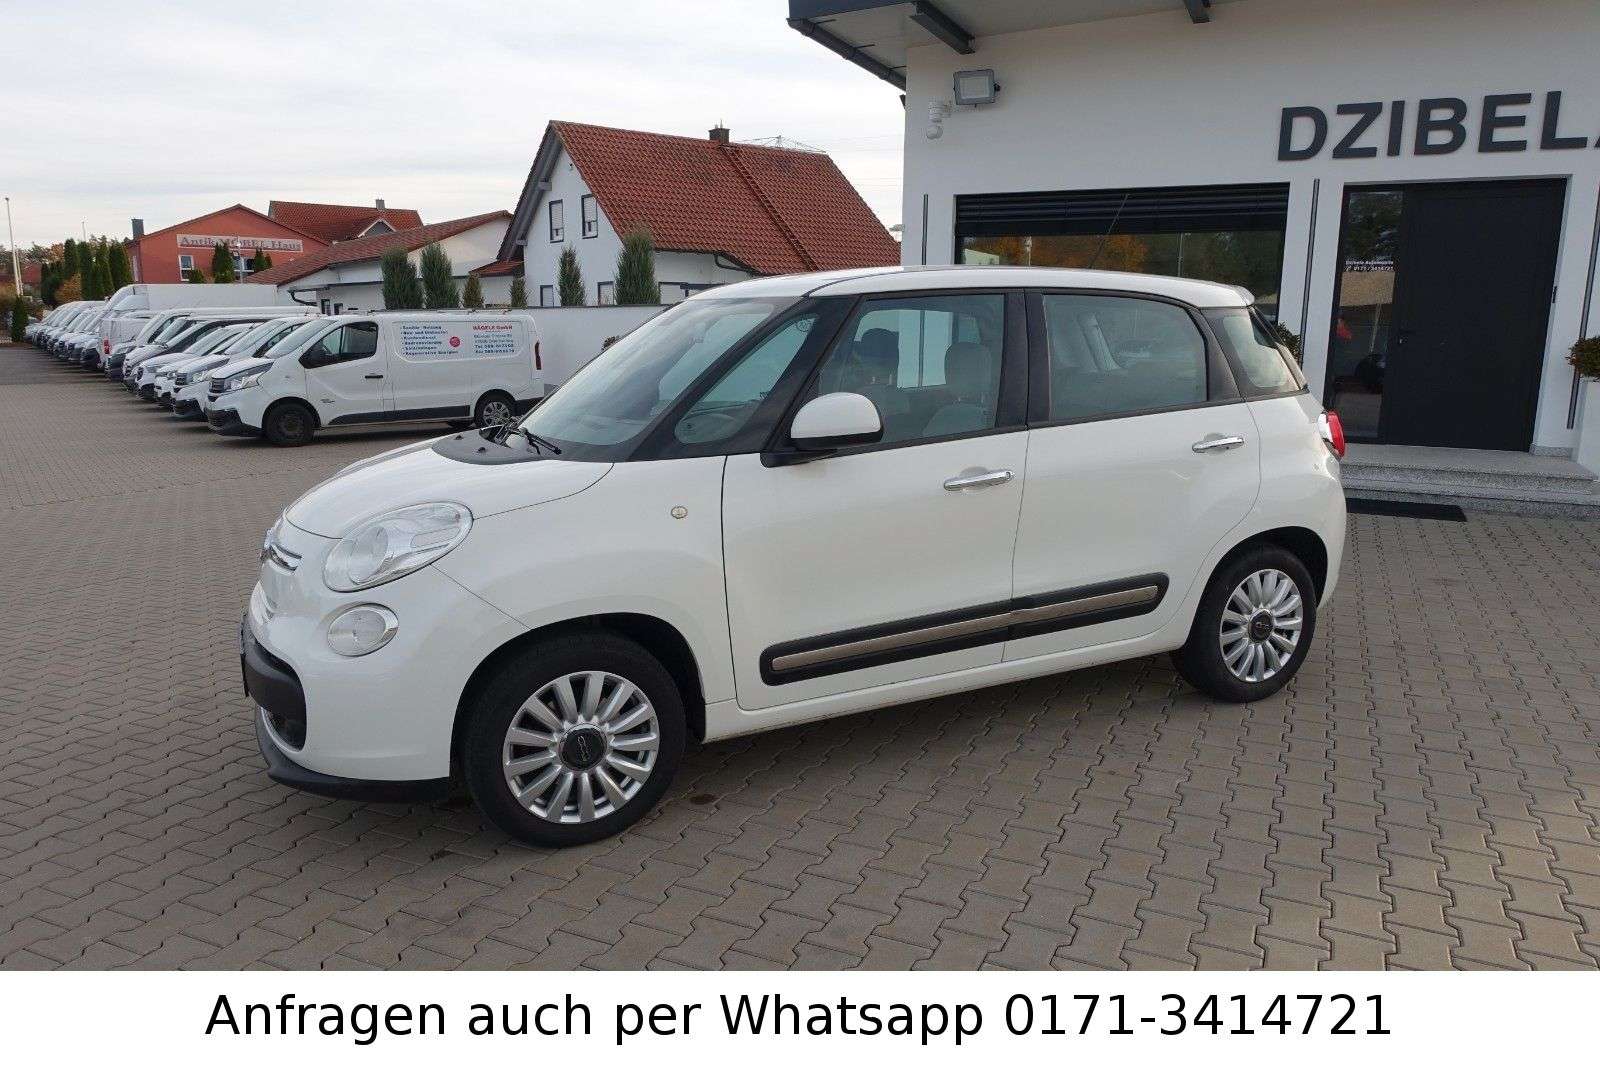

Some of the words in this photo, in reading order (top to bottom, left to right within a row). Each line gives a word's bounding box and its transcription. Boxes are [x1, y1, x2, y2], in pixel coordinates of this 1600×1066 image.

[1278, 90, 1600, 161] DZIBEL
[181, 236, 215, 247] Antik
[271, 240, 301, 251] Haus
